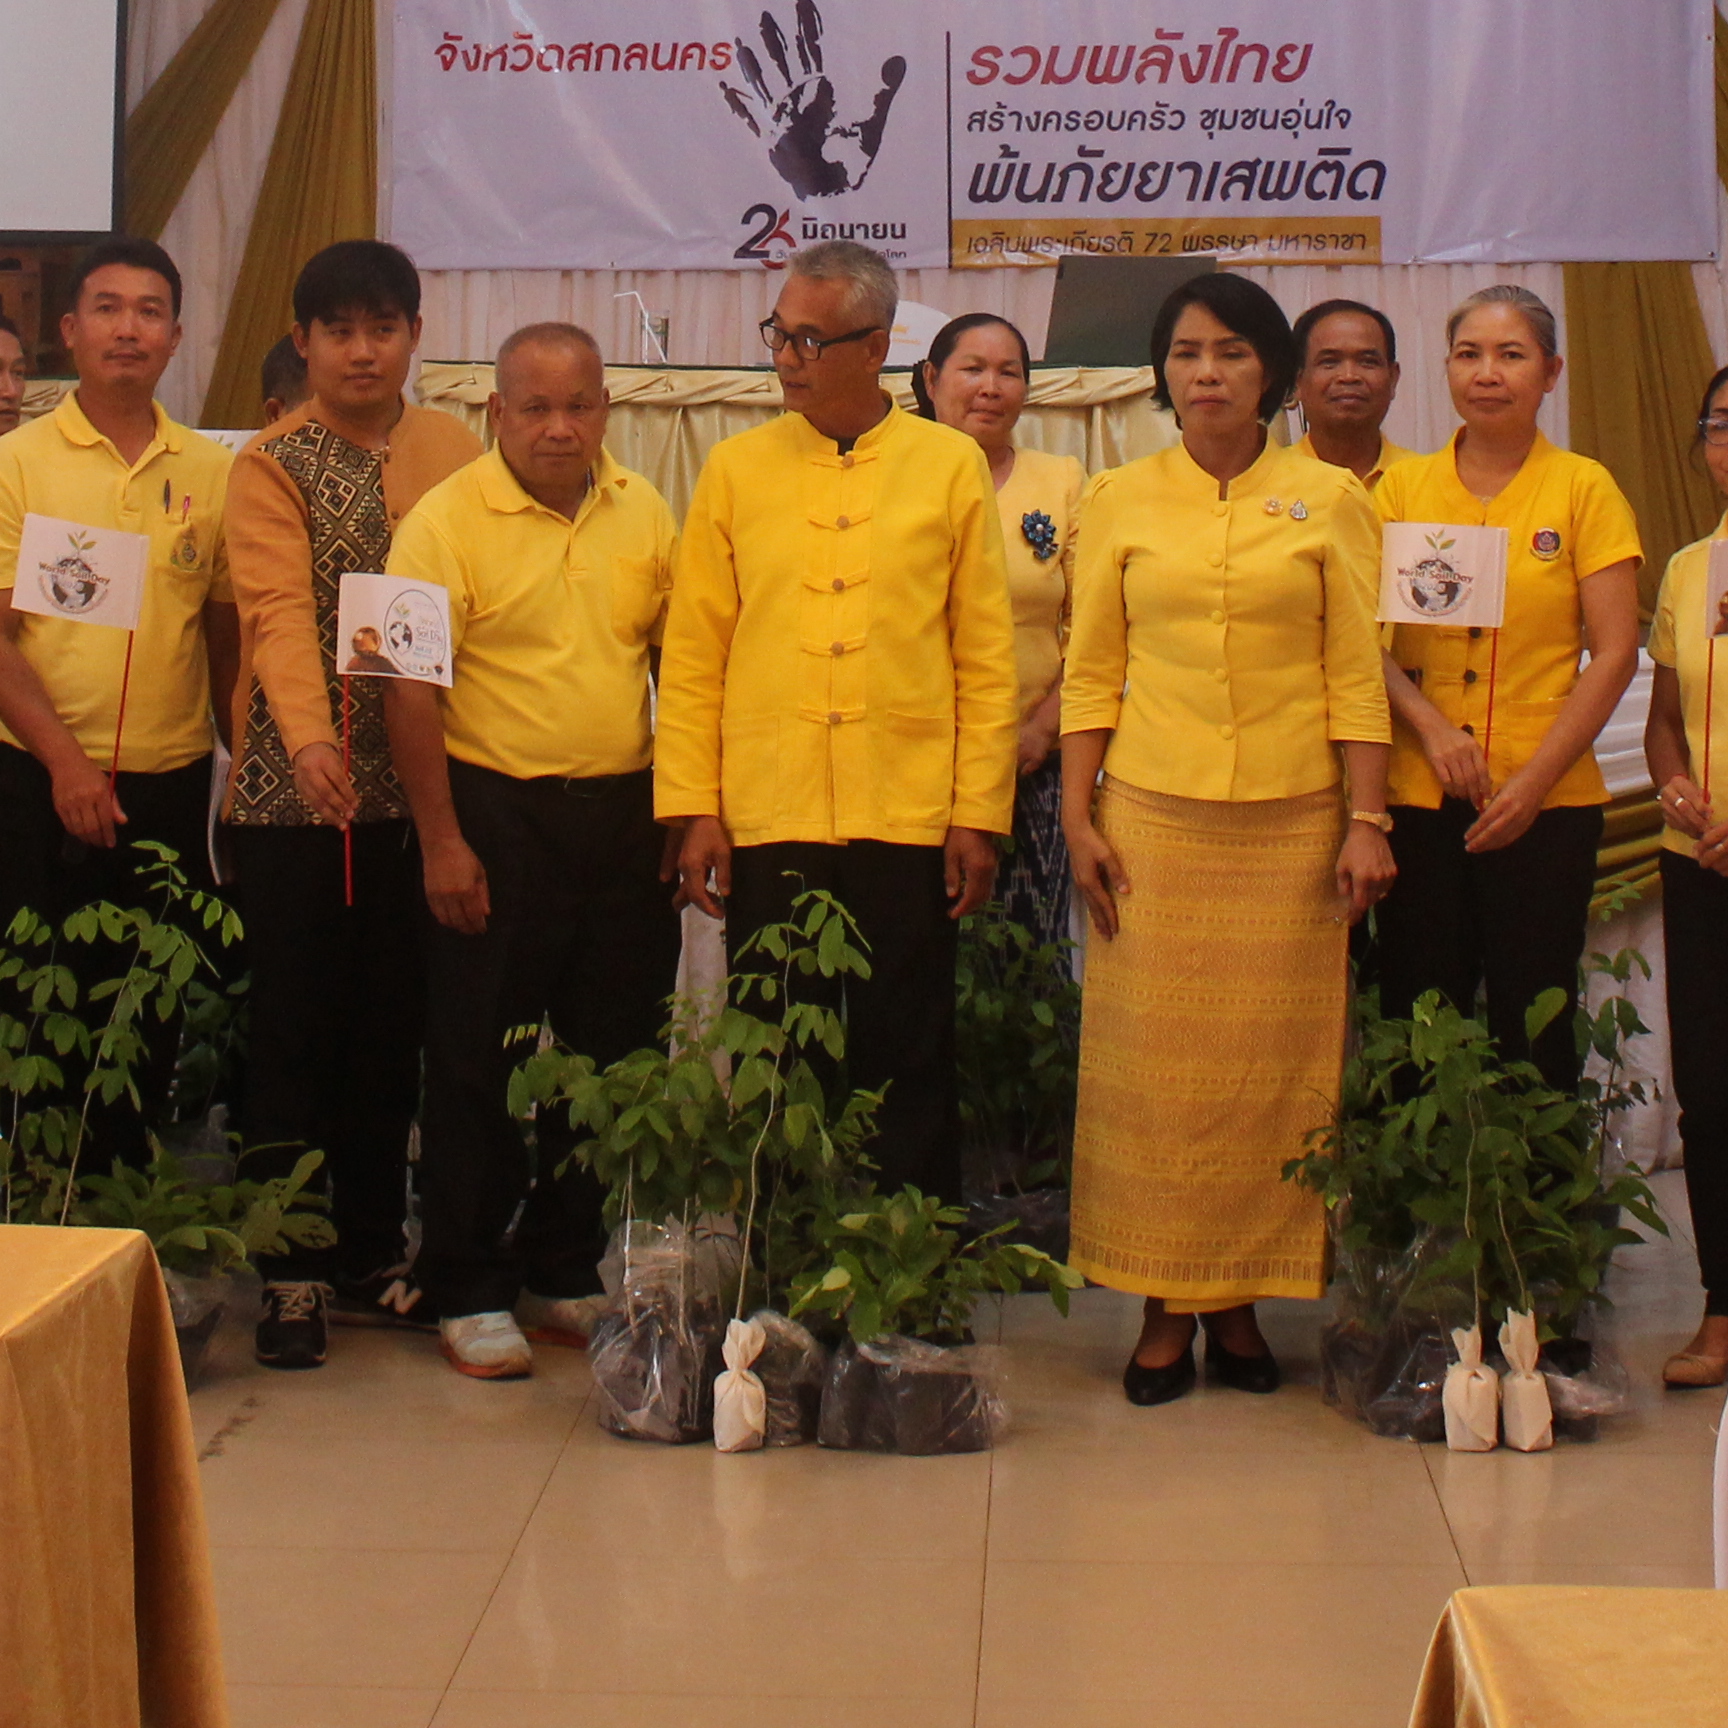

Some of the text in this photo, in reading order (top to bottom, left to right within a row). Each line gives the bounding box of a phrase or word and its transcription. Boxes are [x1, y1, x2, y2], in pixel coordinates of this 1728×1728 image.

[434, 31, 733, 73] จังหวัดสกลนคร
[966, 27, 1313, 86] รวมพลังไทย
[966, 99, 1352, 140] สร้างครอบครัว ชุมชนอุ่นใจ
[967, 144, 1387, 203] พ้นภัยยาเสพติด
[966, 230, 1134, 254] เฉลิมพระเกียรติ
[1144, 233, 1173, 252] 72
[1182, 231, 1257, 252] พรรษา
[1397, 567, 1426, 578] World
